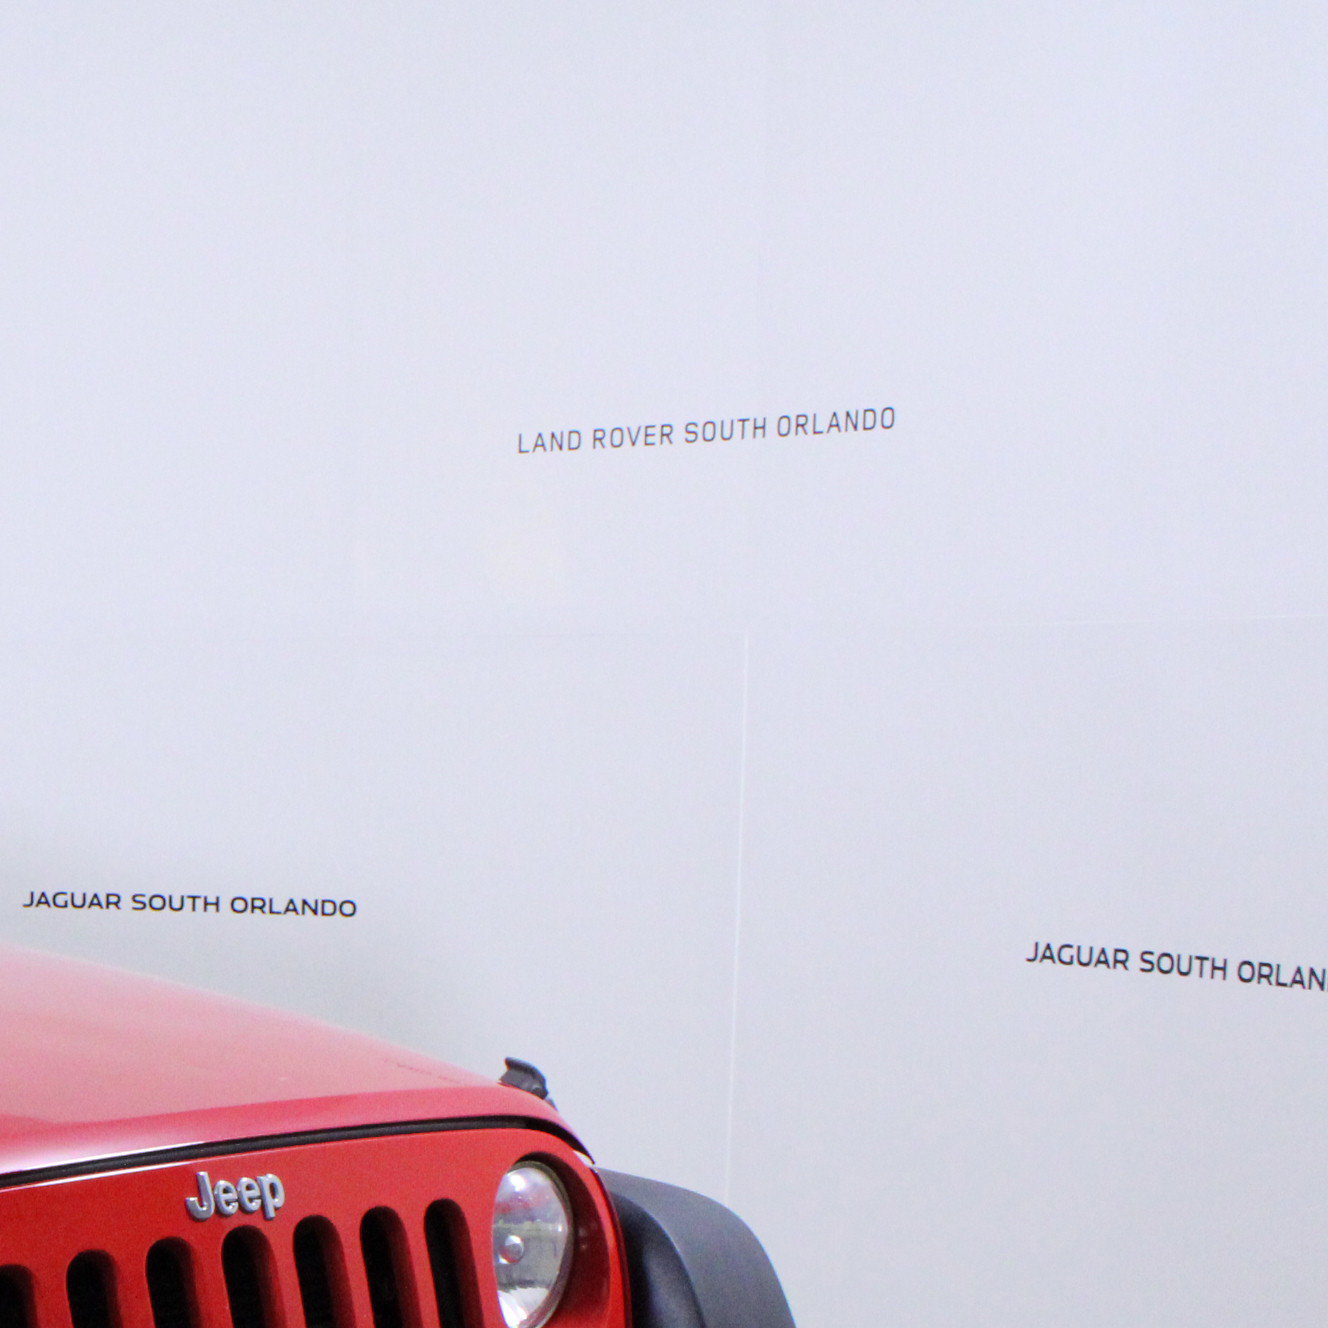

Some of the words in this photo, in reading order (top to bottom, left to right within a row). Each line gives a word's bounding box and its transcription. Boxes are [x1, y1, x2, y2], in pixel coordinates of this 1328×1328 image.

[517, 428, 583, 454] LAND
[591, 422, 675, 450] ROVER
[683, 416, 768, 445] SOUTH
[776, 405, 897, 439] ORLANDO
[22, 890, 123, 911] JAGUAR
[130, 893, 221, 914] SOUTH
[229, 896, 359, 919] ORLANDO
[1025, 940, 1131, 972] JAGUAR
[1138, 949, 1229, 982] SOUTH
[1236, 959, 1328, 993] ORLAN
[185, 1170, 286, 1221] Jeep
